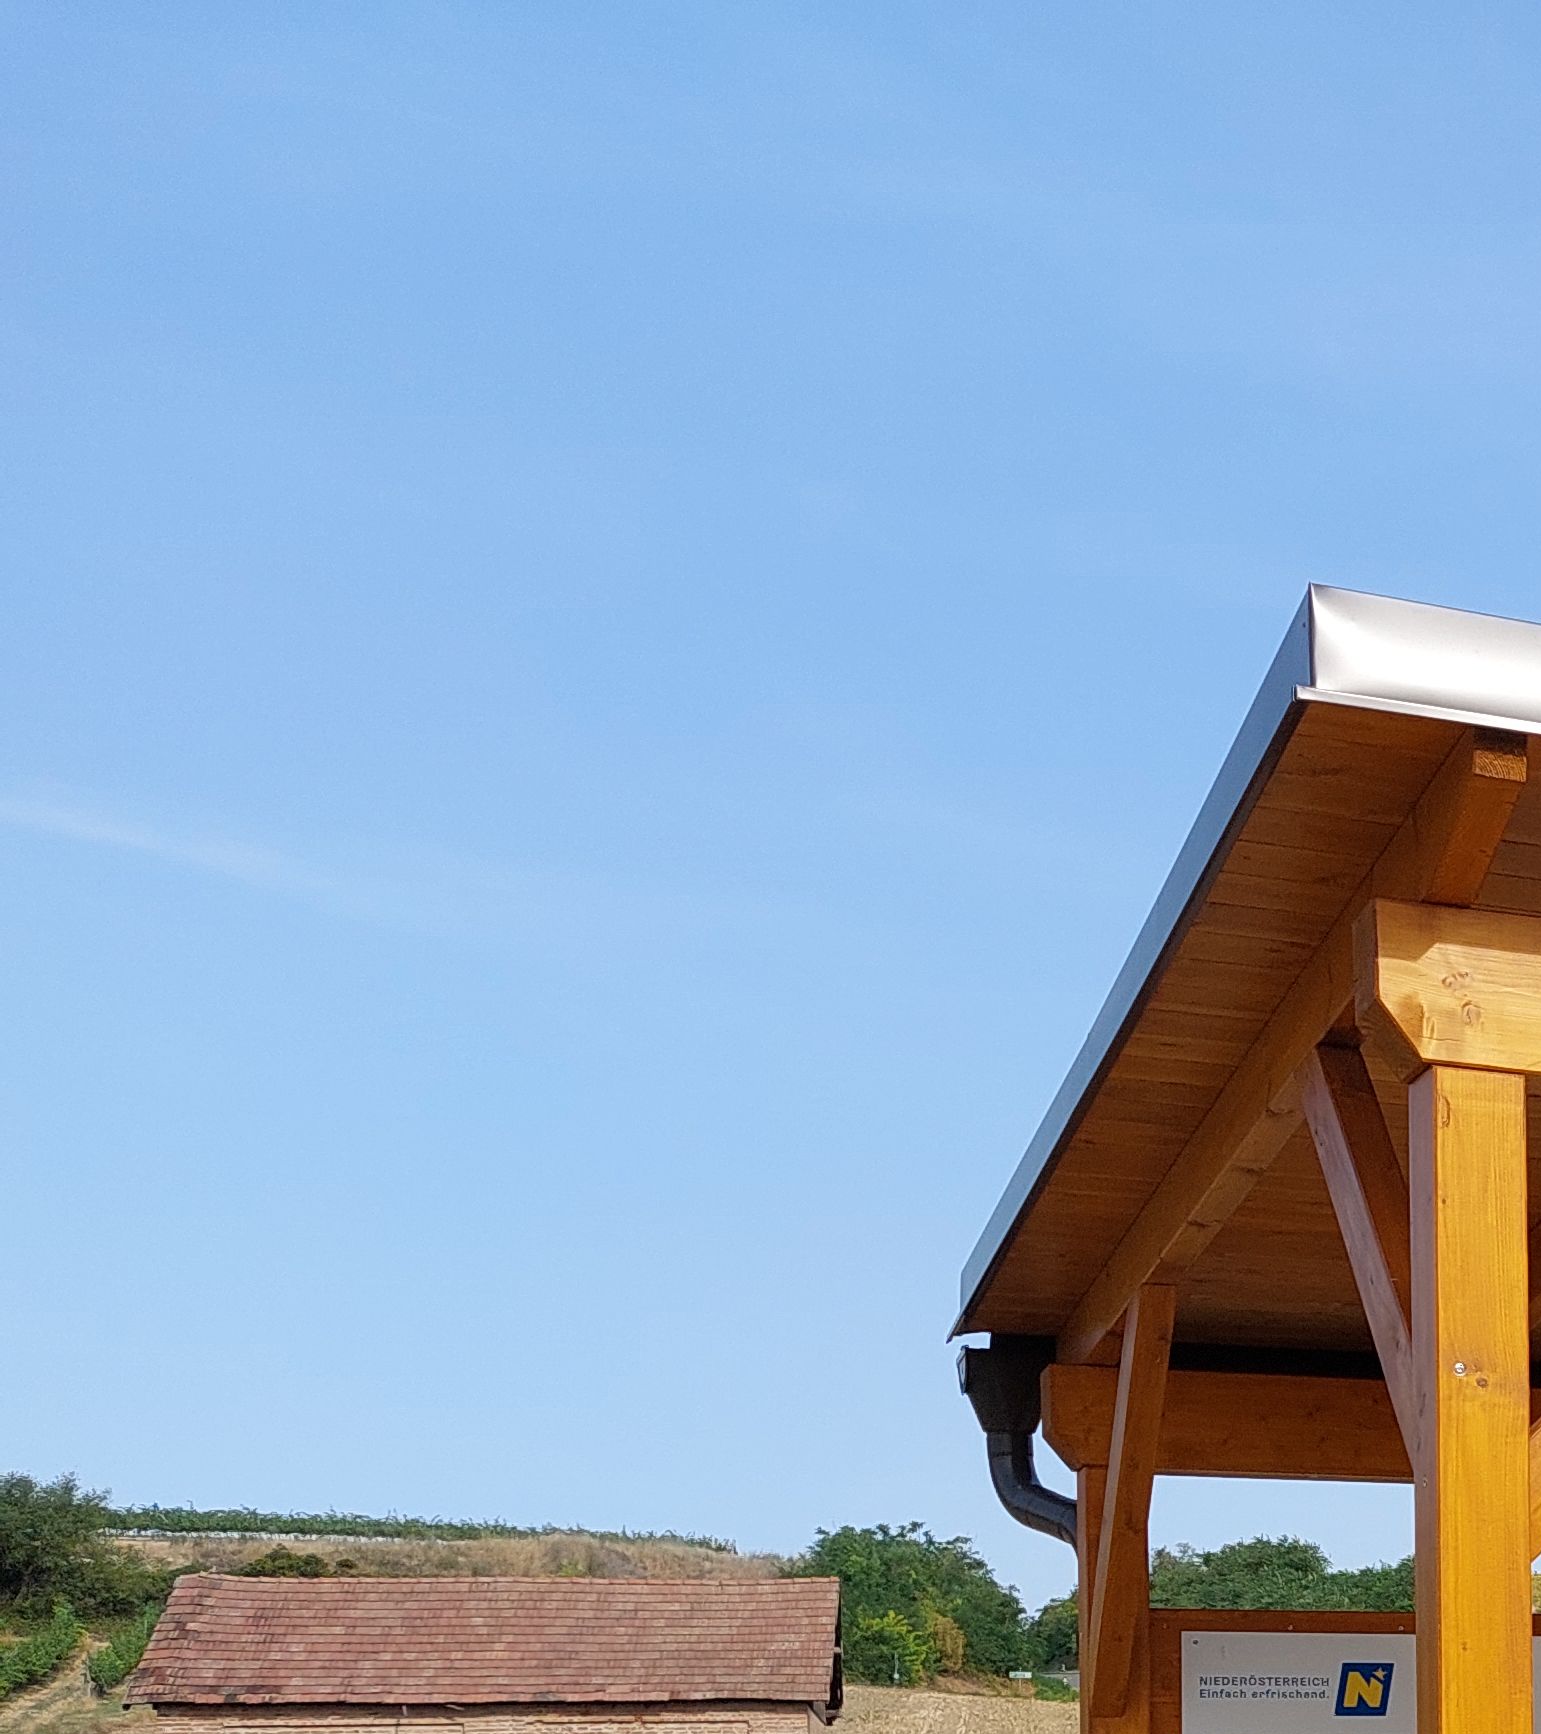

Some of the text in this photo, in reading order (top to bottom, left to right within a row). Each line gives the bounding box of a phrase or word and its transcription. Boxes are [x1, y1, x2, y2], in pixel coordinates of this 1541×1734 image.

[1200, 1675, 1330, 1686] NIEDERÖSTERREICH
[1200, 1688, 1330, 1699] Einfach erfrischend.
